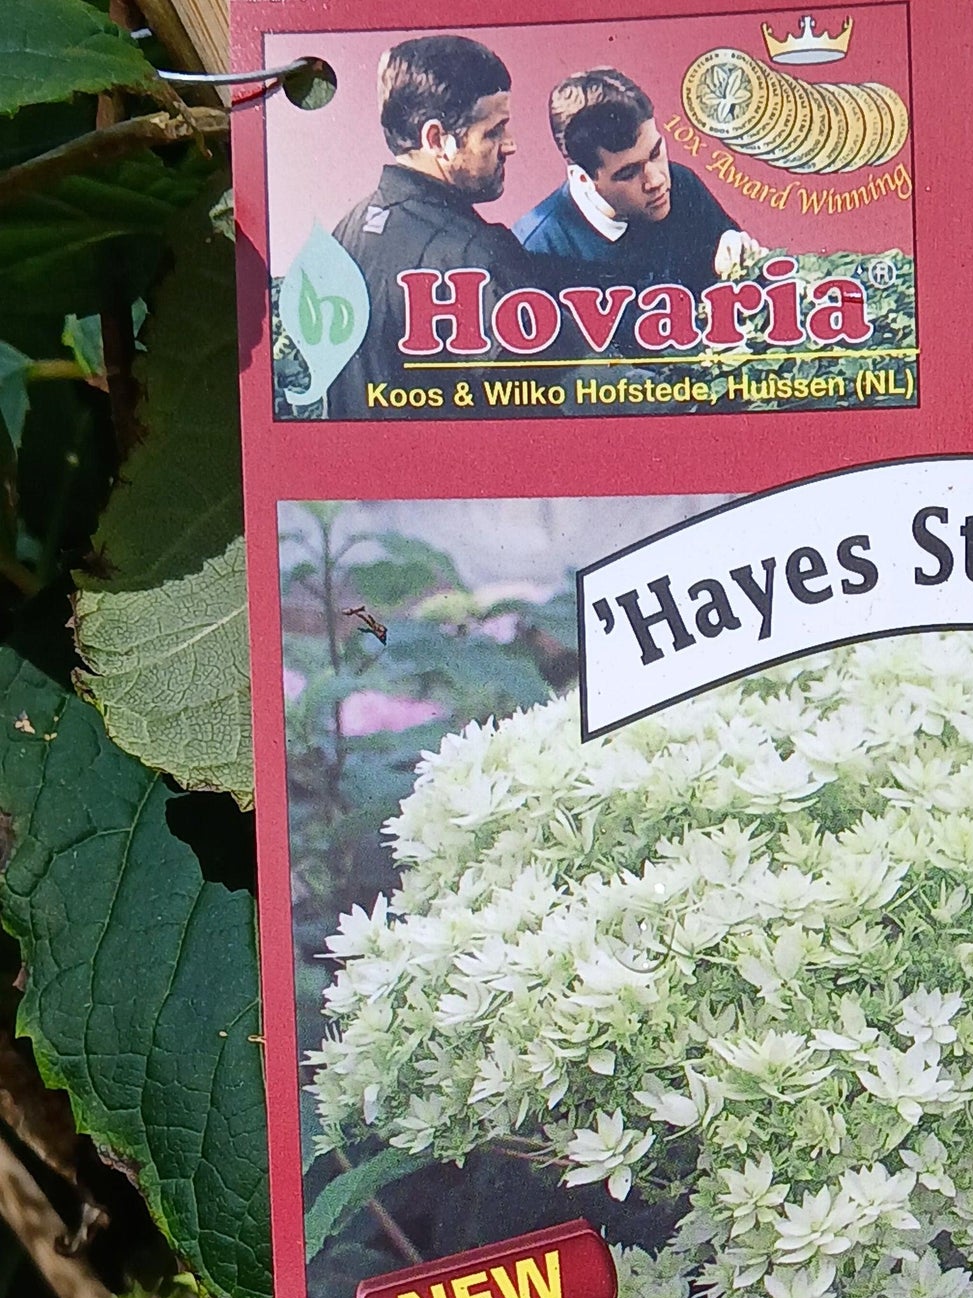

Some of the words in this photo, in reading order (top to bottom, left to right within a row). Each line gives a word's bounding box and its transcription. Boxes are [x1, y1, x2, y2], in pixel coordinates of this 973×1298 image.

[705, 150, 800, 210] Award
[798, 162, 912, 215] Winning
[397, 257, 874, 358] Hovaria
[367, 382, 444, 409] Koos
[453, 382, 475, 408] &
[483, 379, 567, 408] Wilko
[575, 378, 718, 405] Hofstede,
[727, 376, 846, 399] Huissen
[855, 372, 915, 401] (NL)
